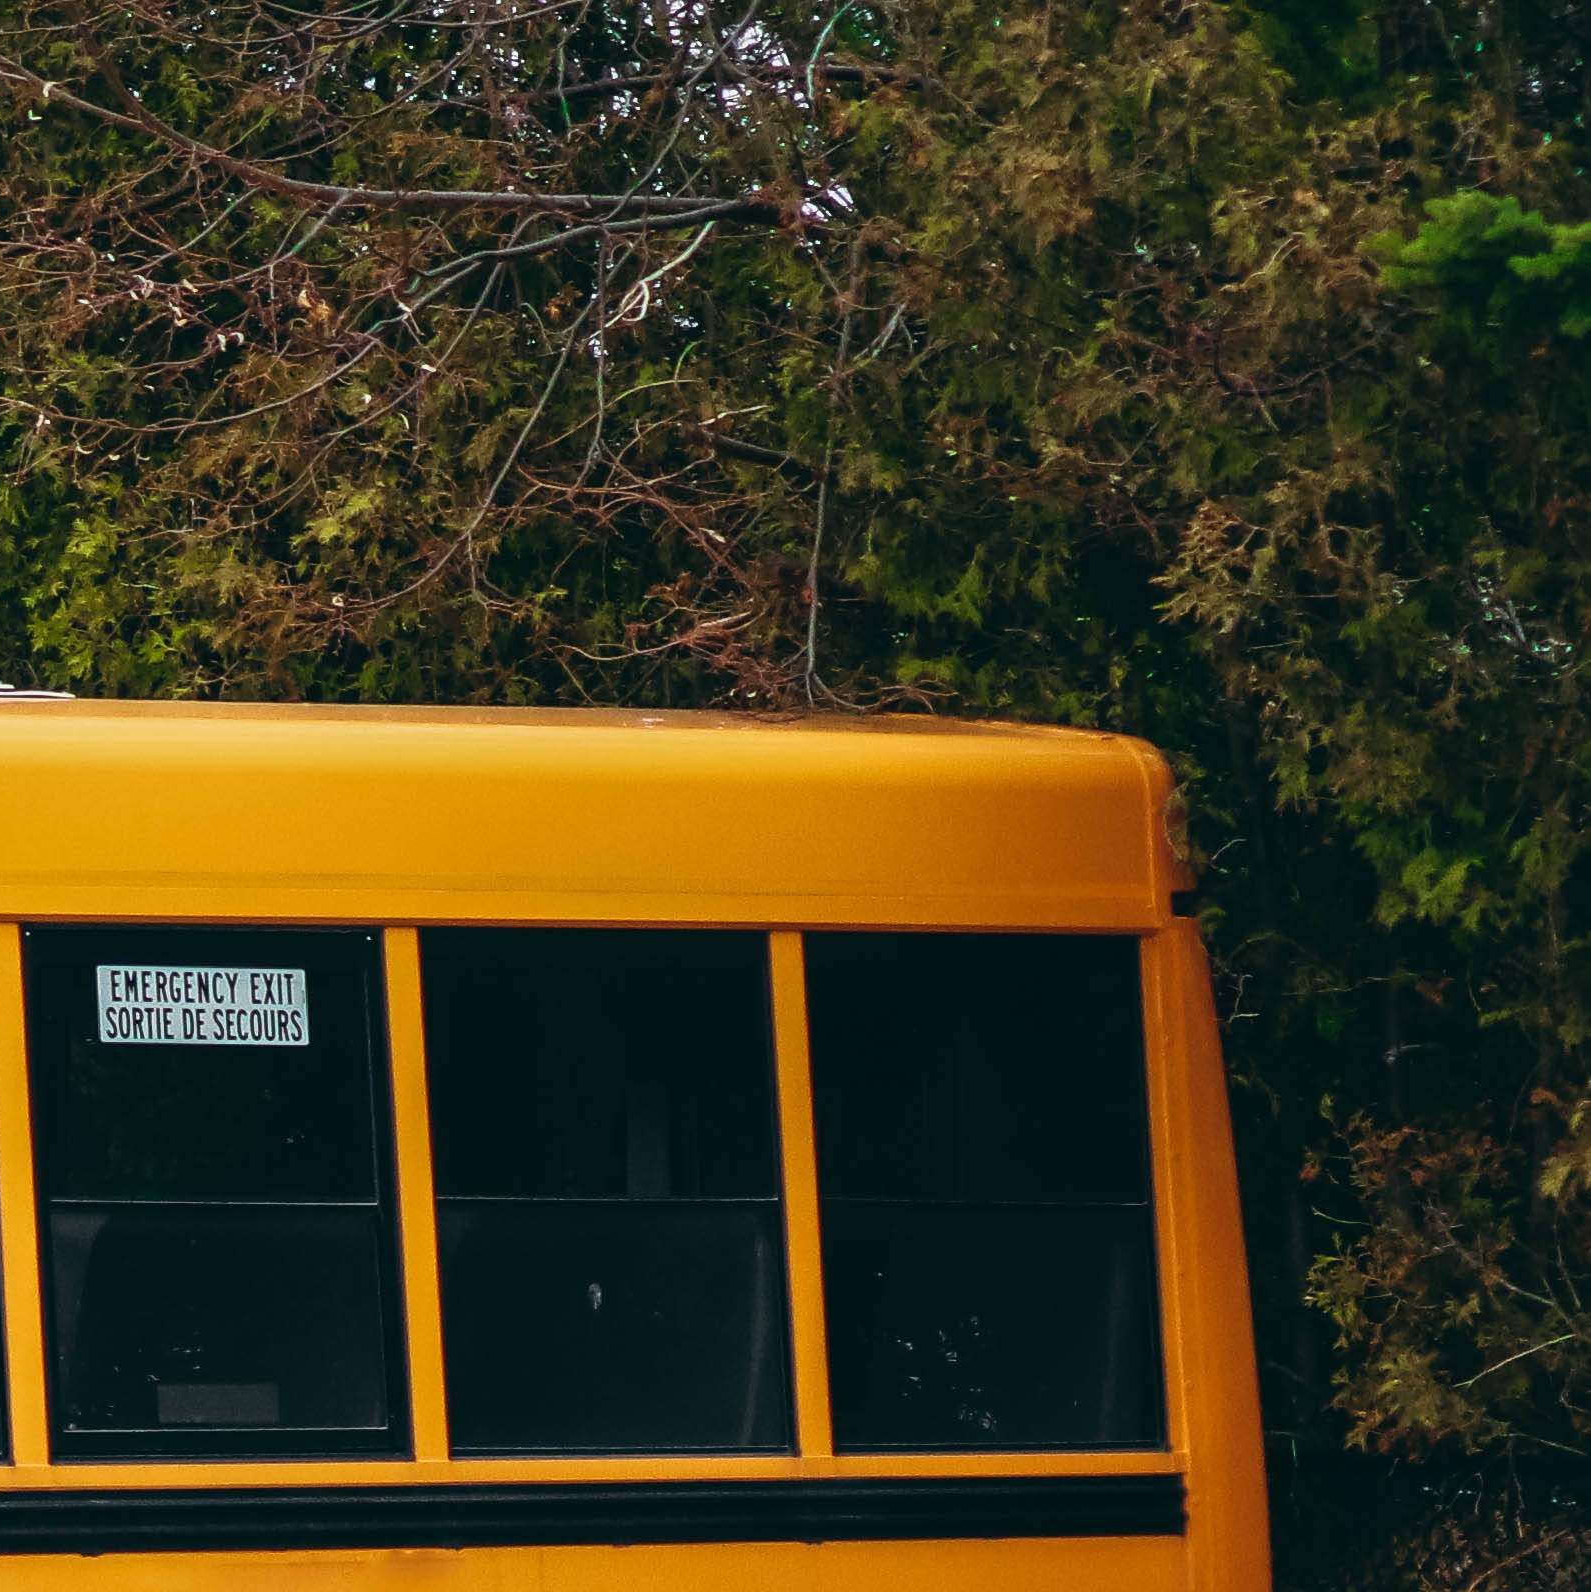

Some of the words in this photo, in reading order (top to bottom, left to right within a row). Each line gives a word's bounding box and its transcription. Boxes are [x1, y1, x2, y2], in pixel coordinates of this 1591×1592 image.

[110, 970, 238, 1004] EMERGENCY
[250, 973, 294, 1005] EXIT
[106, 1006, 175, 1039] SORTIE
[182, 1008, 207, 1040] DE
[213, 1009, 302, 1041] SECOURS
